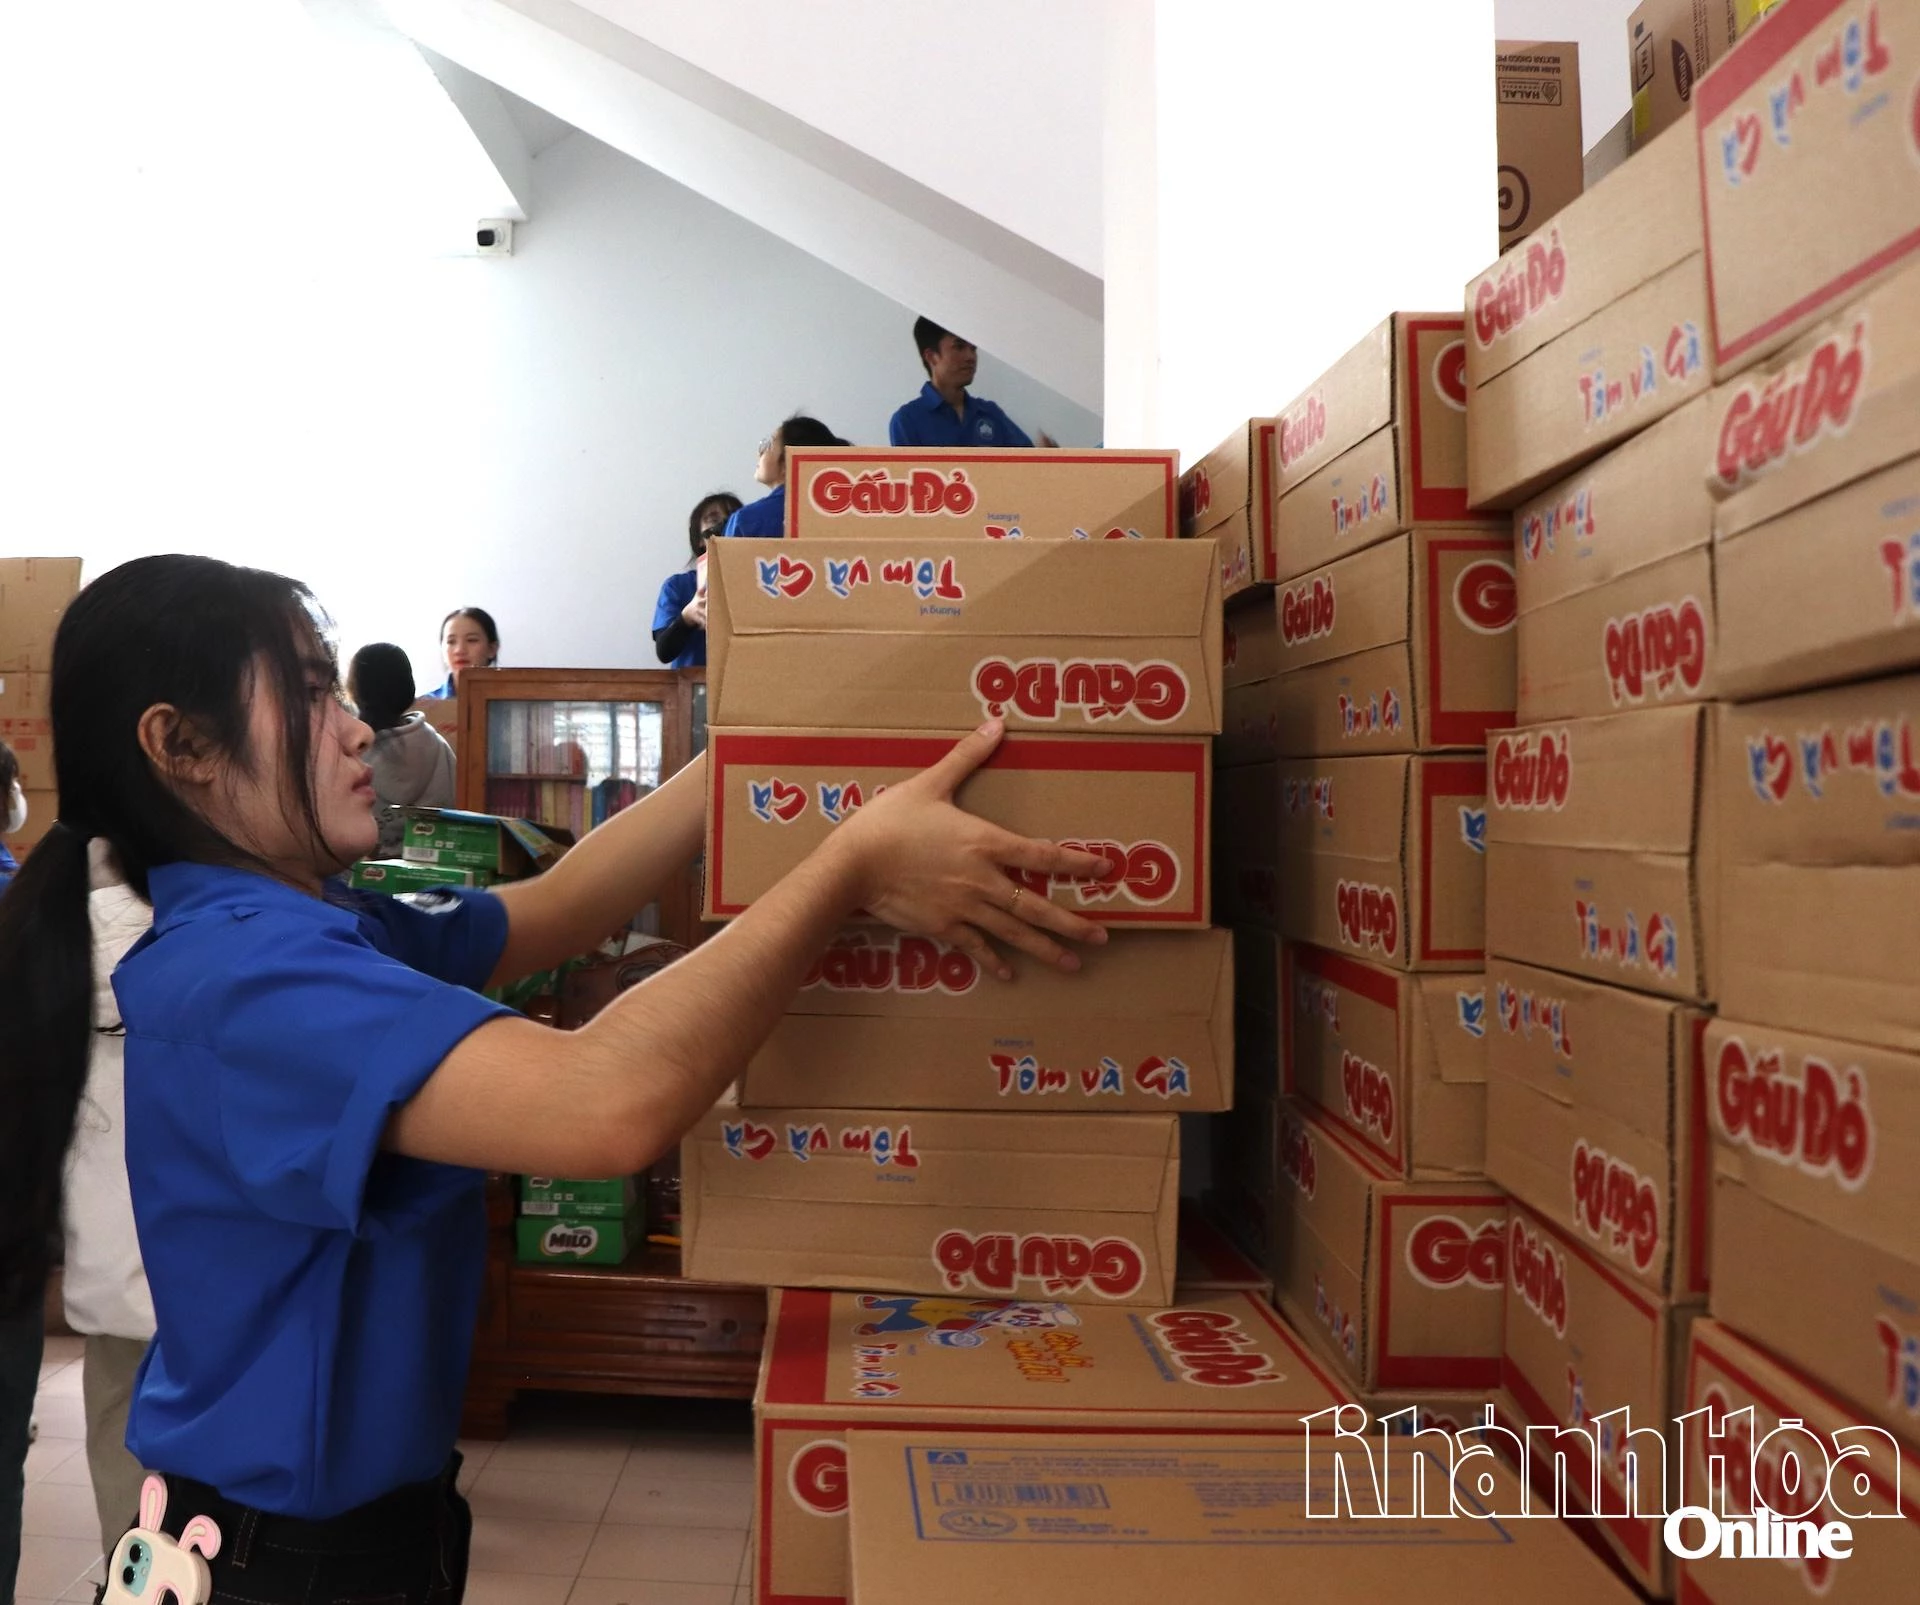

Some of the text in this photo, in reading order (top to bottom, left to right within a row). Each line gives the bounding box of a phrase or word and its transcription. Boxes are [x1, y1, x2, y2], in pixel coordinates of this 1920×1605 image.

[1502, 90, 1540, 99] HALAL
[760, 555, 964, 598] Tôm và Gà
[990, 1055, 1190, 1093] Tôm và Gà
[550, 1233, 592, 1248] MILO
